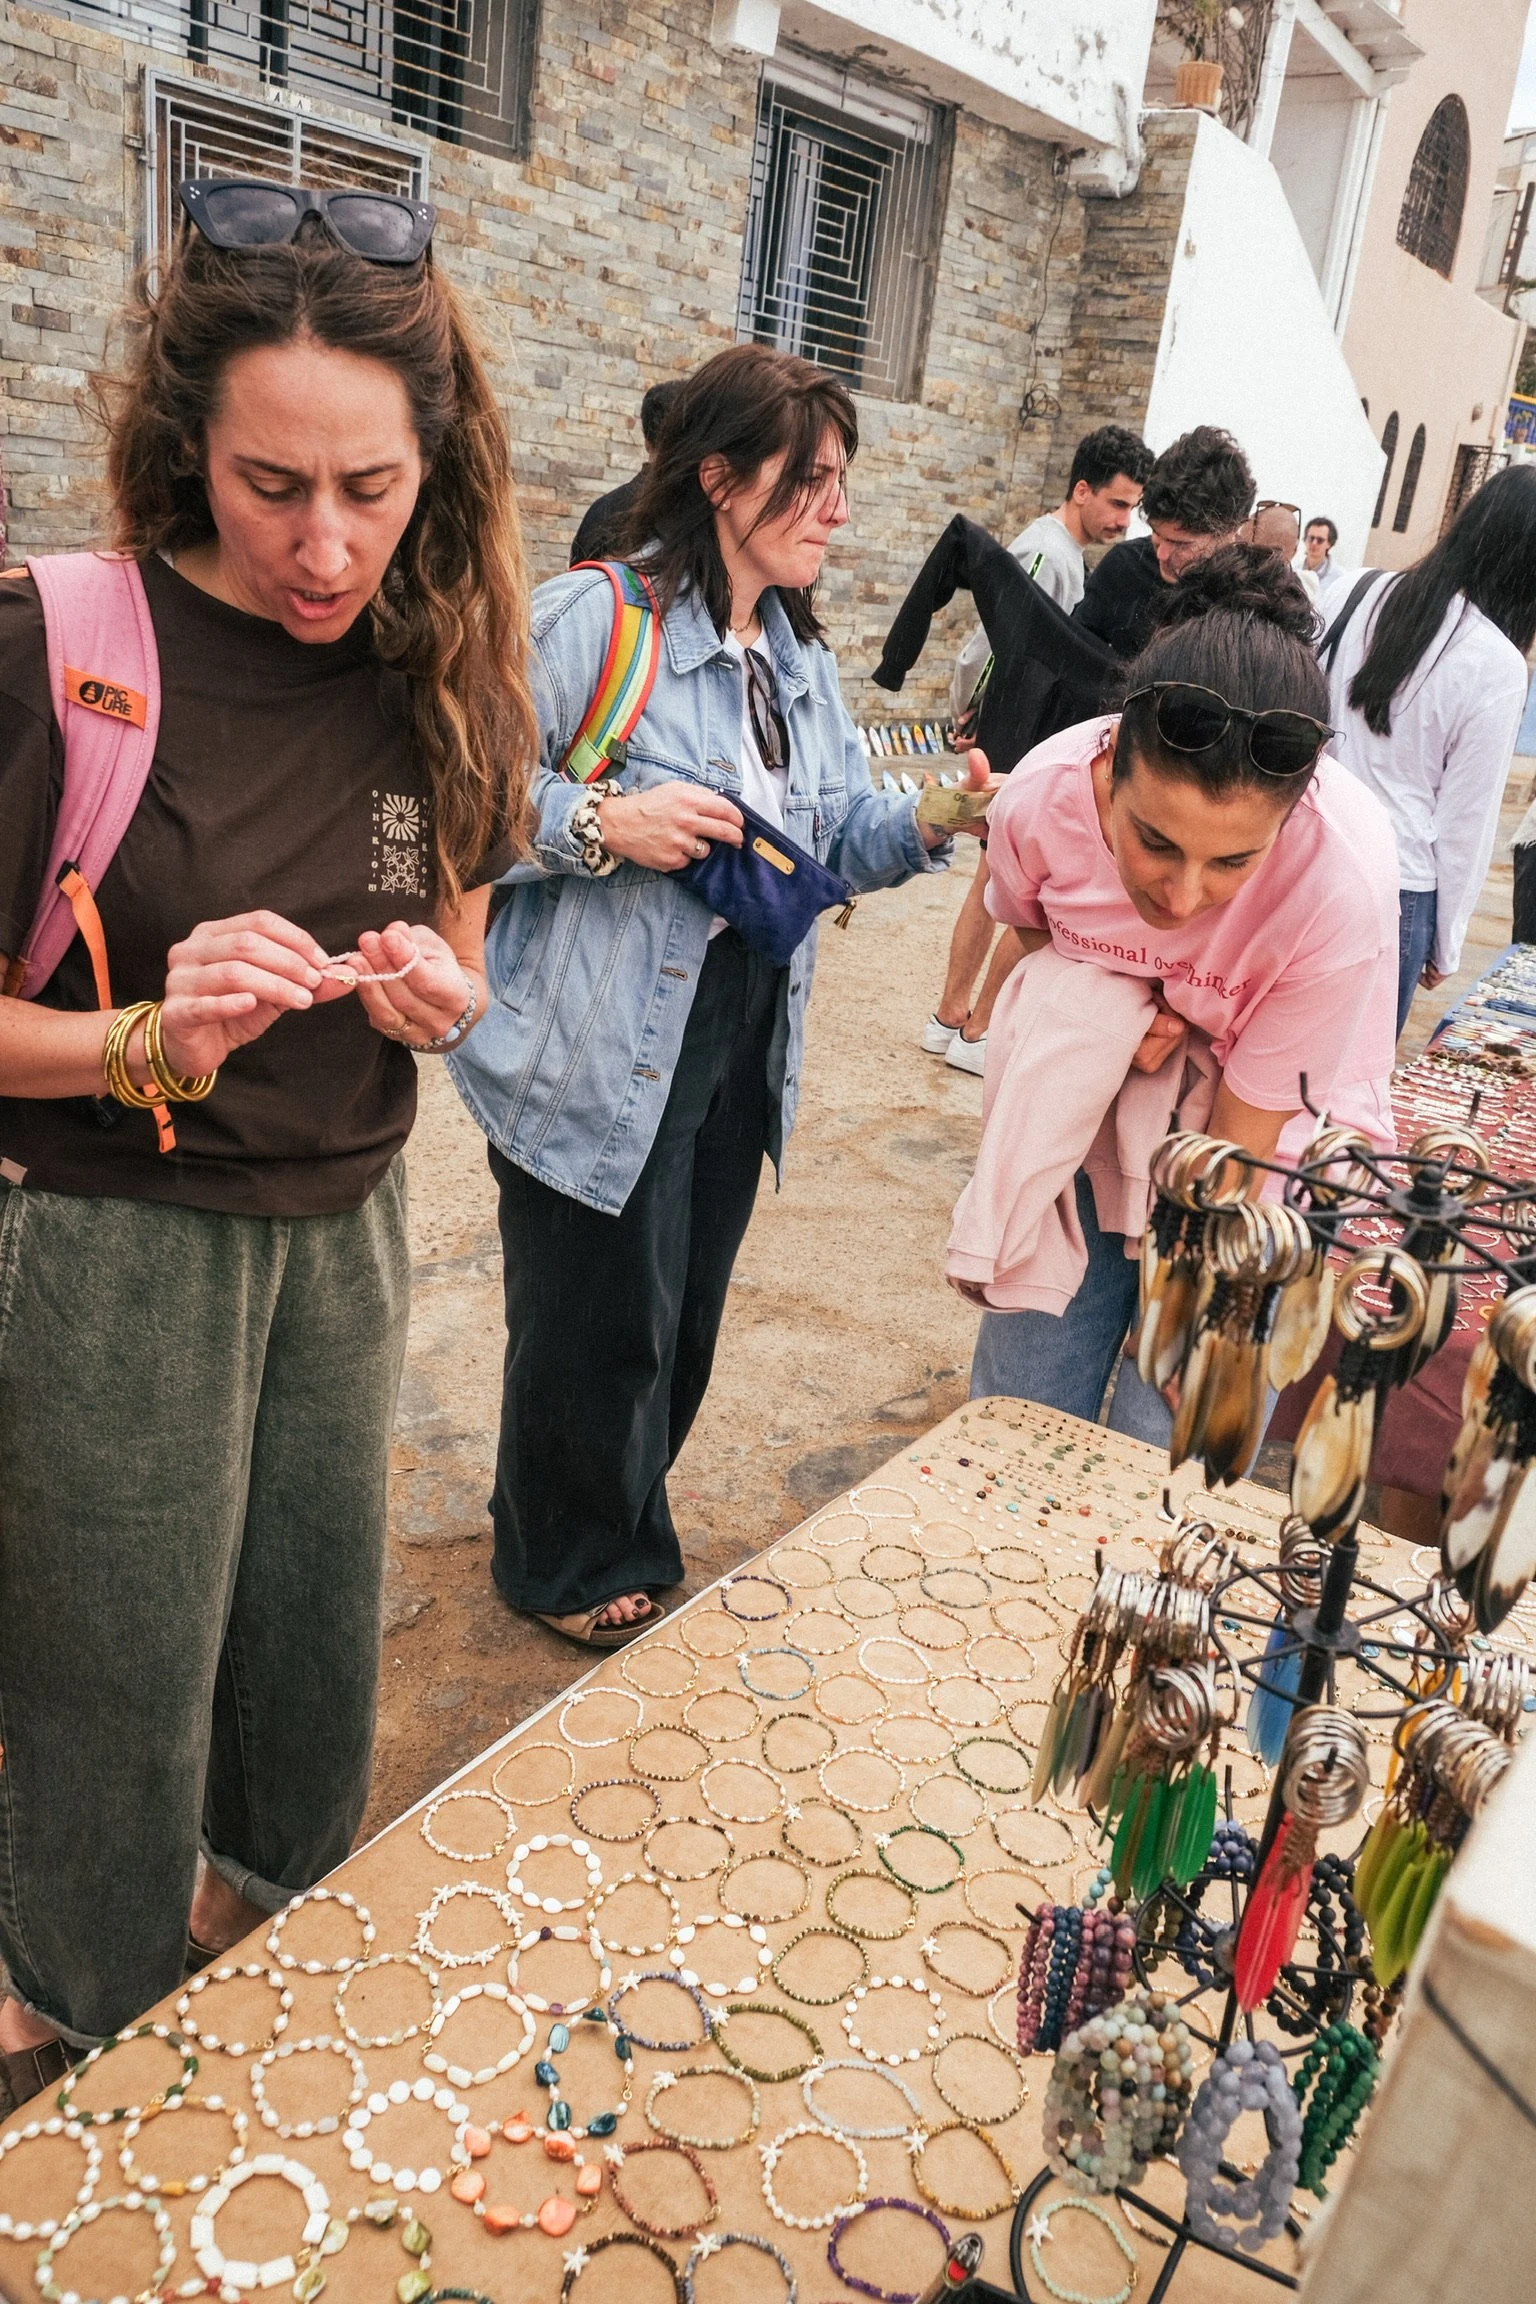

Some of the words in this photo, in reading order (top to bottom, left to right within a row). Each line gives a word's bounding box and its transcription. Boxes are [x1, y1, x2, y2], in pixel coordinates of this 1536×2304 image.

[104, 685, 129, 703] PIC
[102, 697, 133, 716] URE
[1049, 917, 1148, 965] fessional
